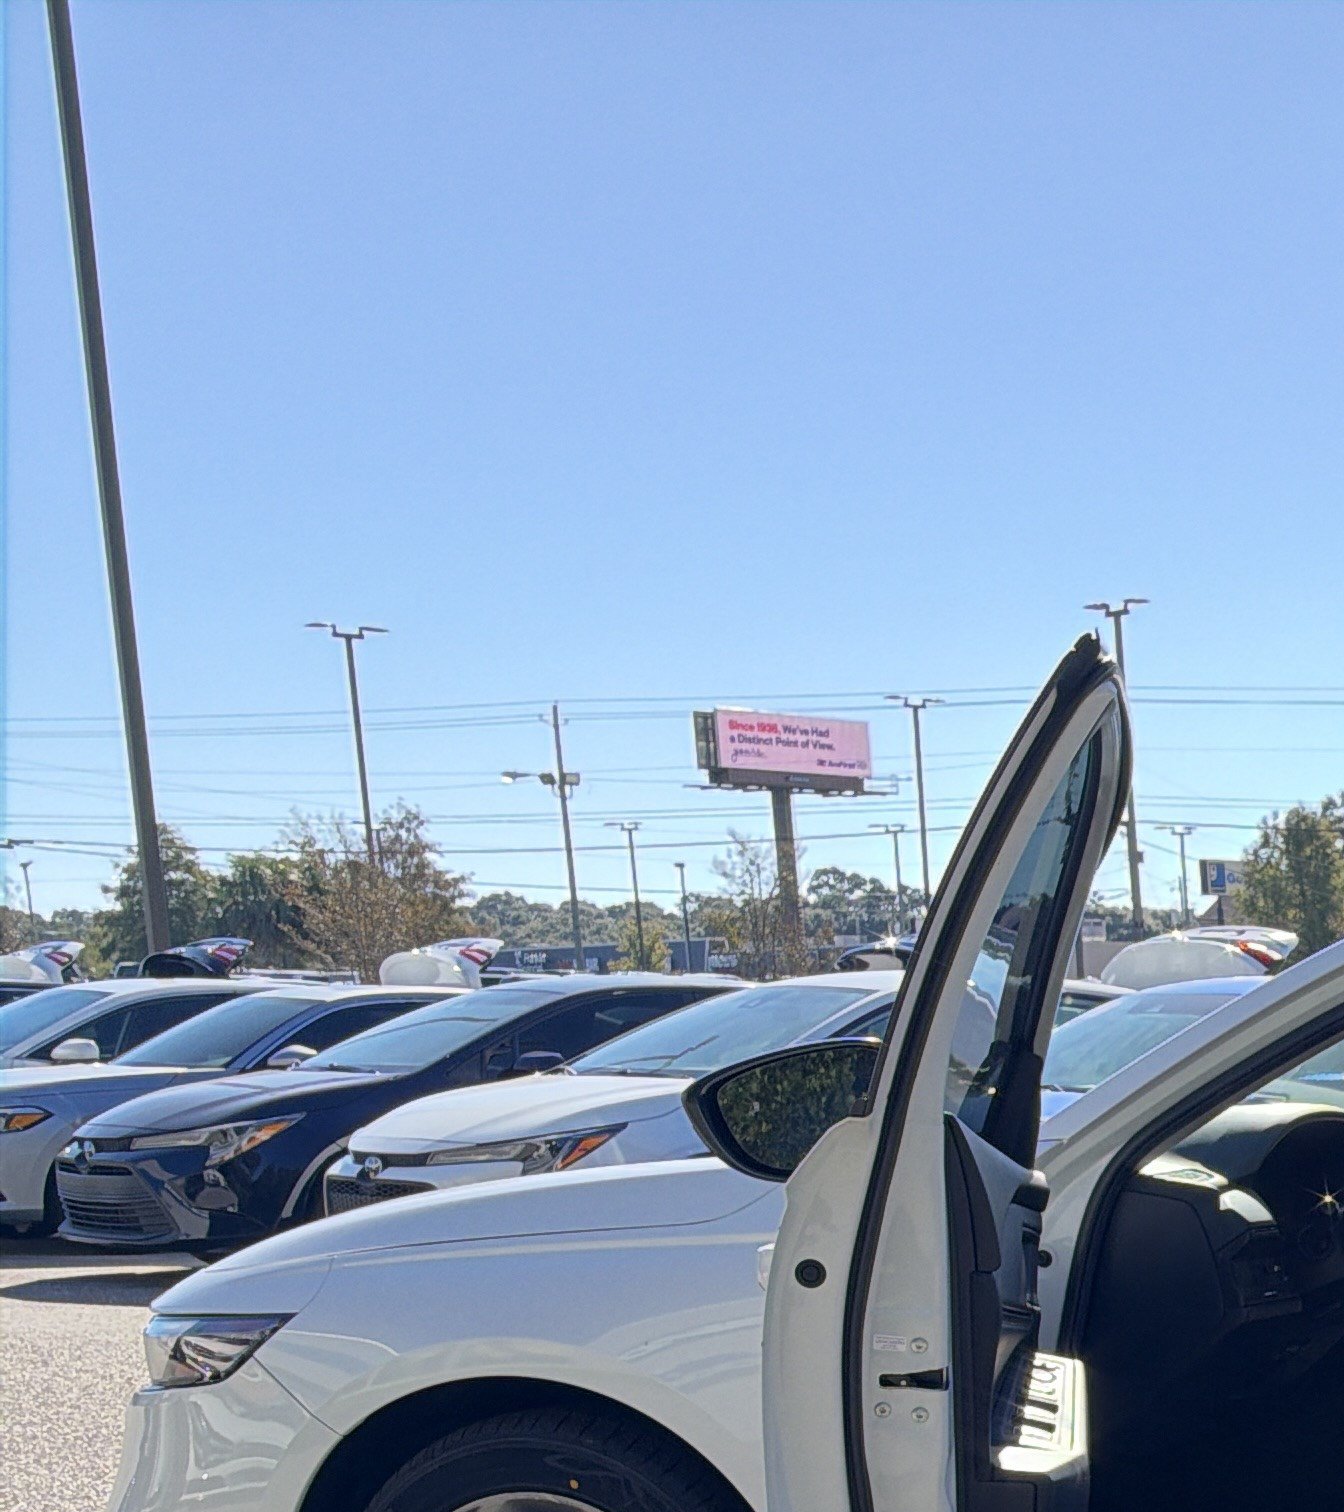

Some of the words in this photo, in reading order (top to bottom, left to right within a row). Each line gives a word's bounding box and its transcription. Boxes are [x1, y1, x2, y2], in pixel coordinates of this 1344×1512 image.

[728, 719, 755, 732] Since
[811, 727, 829, 738] Had
[729, 735, 736, 743] a
[738, 734, 773, 746] Distinct
[776, 736, 799, 748] Point
[801, 740, 810, 749] of
